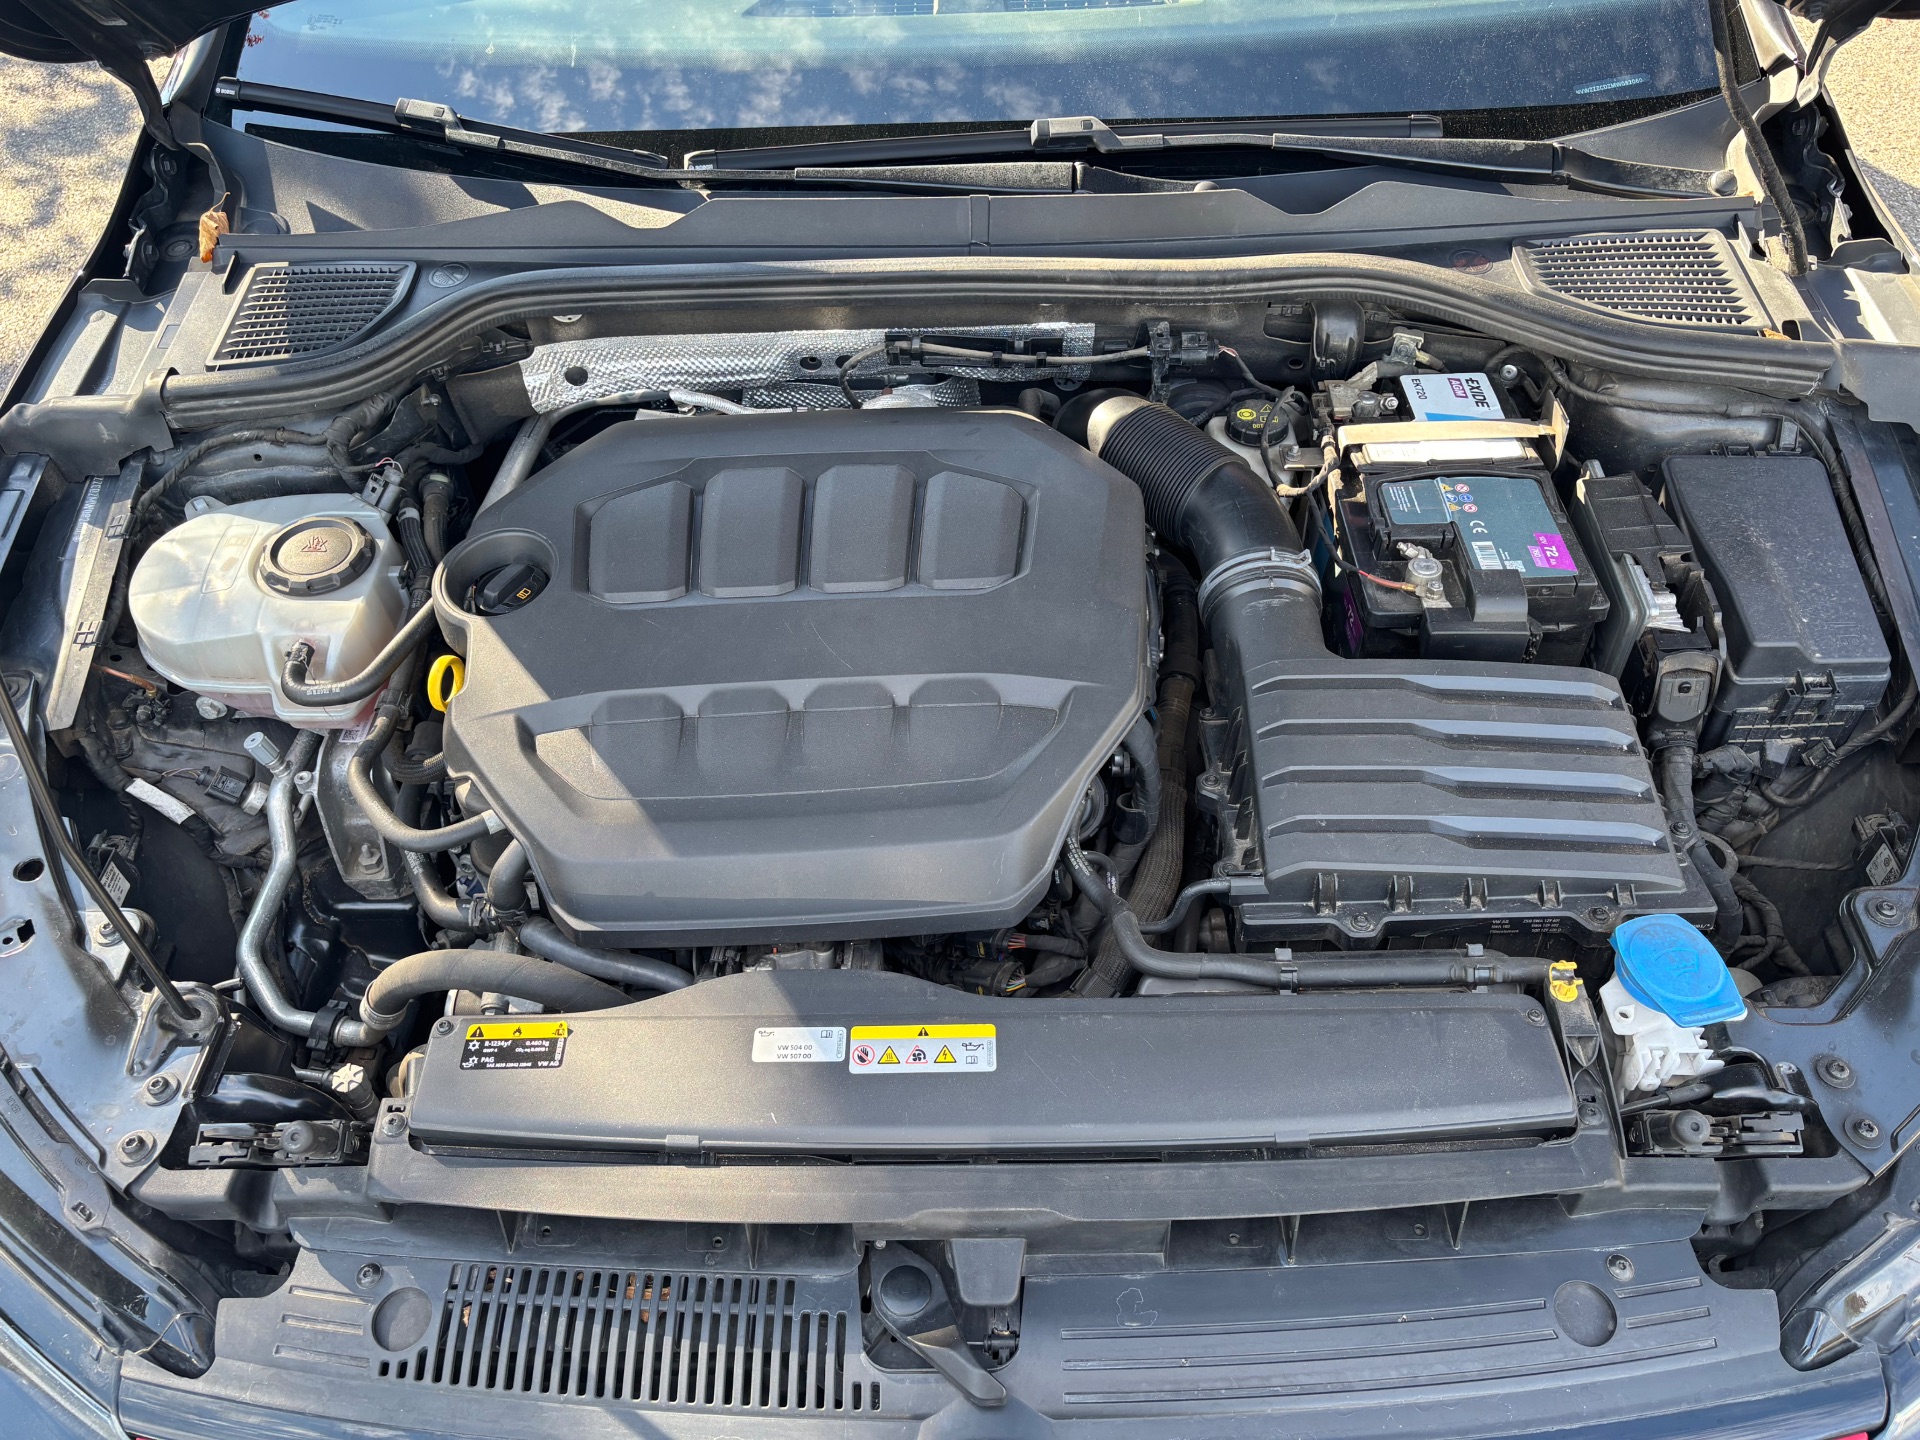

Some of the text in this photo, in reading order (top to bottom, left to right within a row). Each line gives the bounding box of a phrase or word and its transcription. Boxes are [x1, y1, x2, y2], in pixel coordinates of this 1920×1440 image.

[1412, 378, 1428, 400] EK720
[1450, 380, 1466, 398] AGM
[1465, 378, 1490, 408] EXIDE
[1544, 546, 1559, 558] 72
